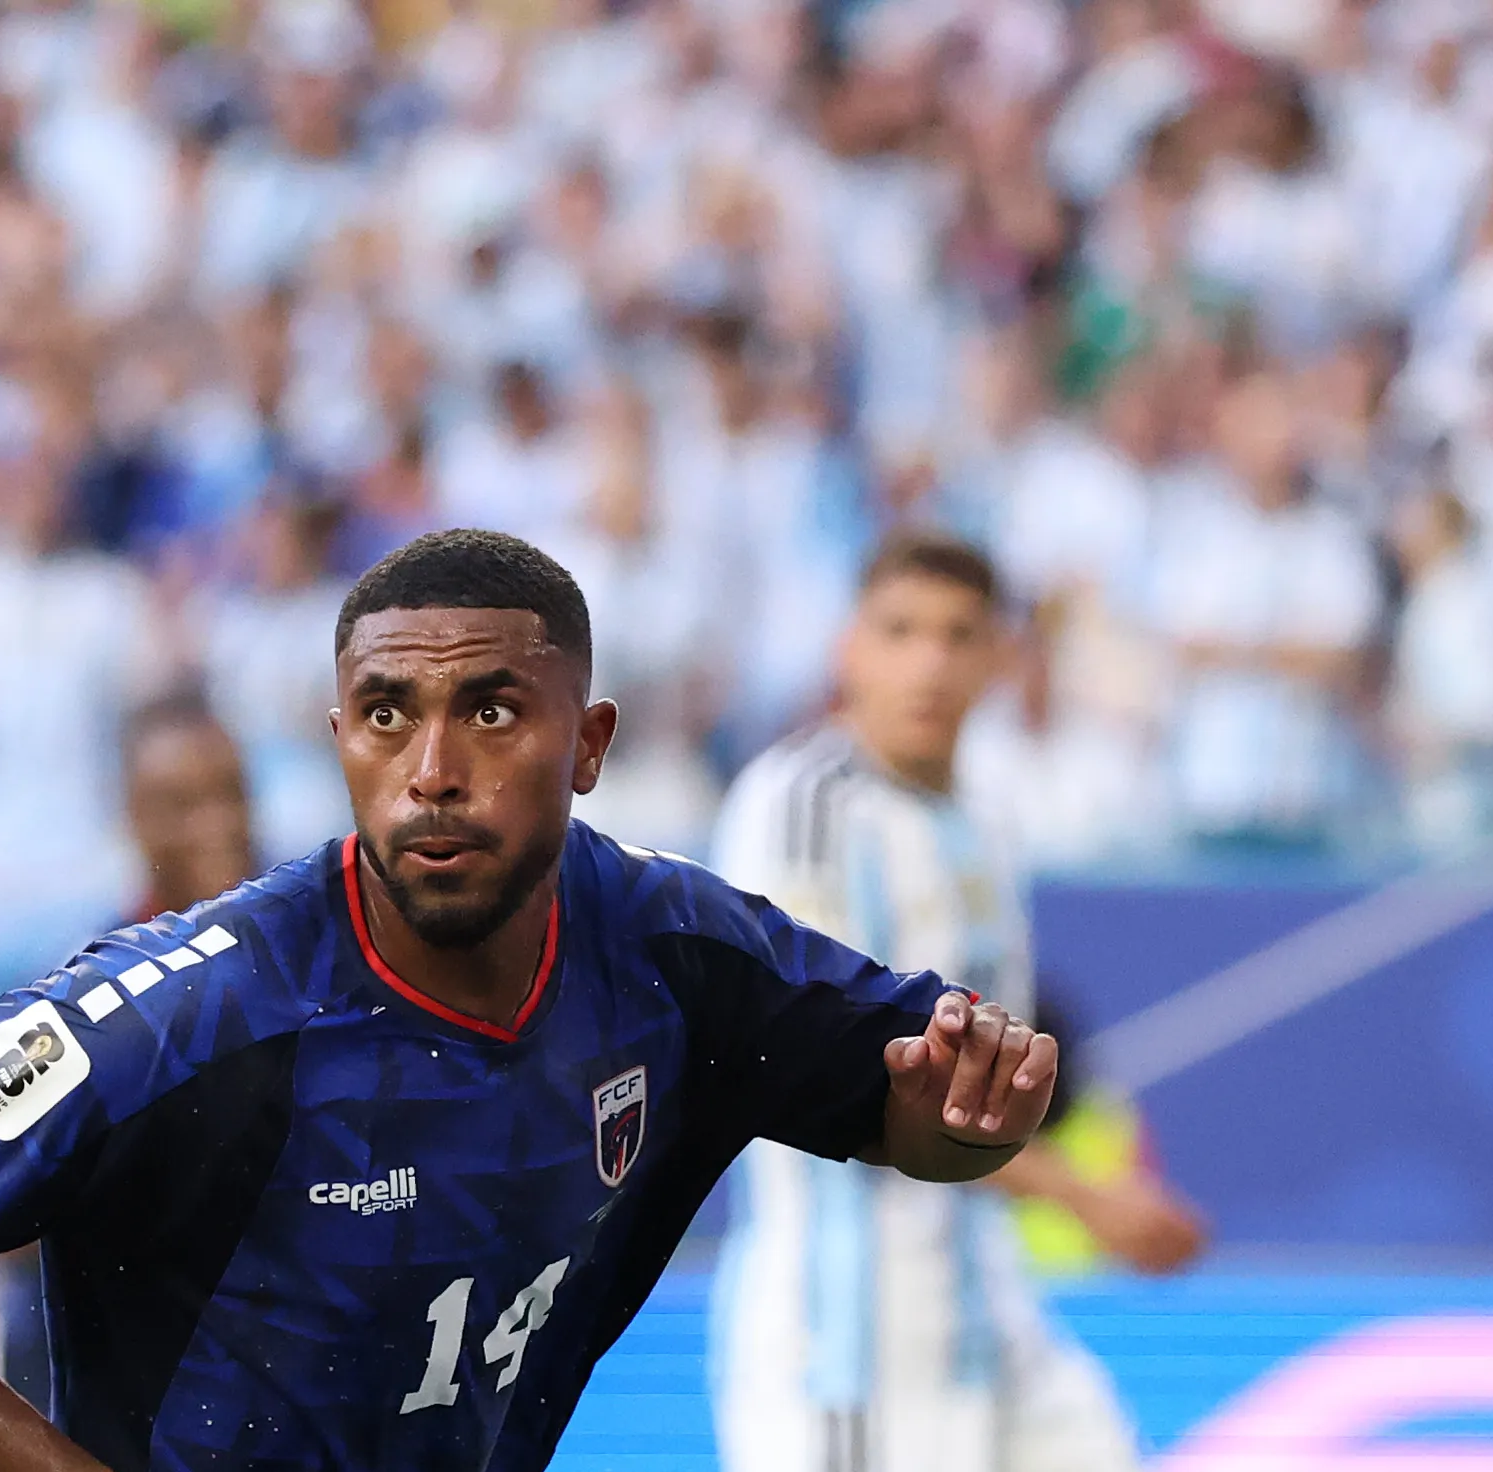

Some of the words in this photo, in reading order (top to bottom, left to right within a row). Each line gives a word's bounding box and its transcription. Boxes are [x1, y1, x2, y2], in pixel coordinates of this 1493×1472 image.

[598, 1073, 643, 1112] FCF
[309, 1166, 417, 1212] capelli
[361, 1197, 418, 1217] SPORT
[399, 1255, 571, 1415] 14
